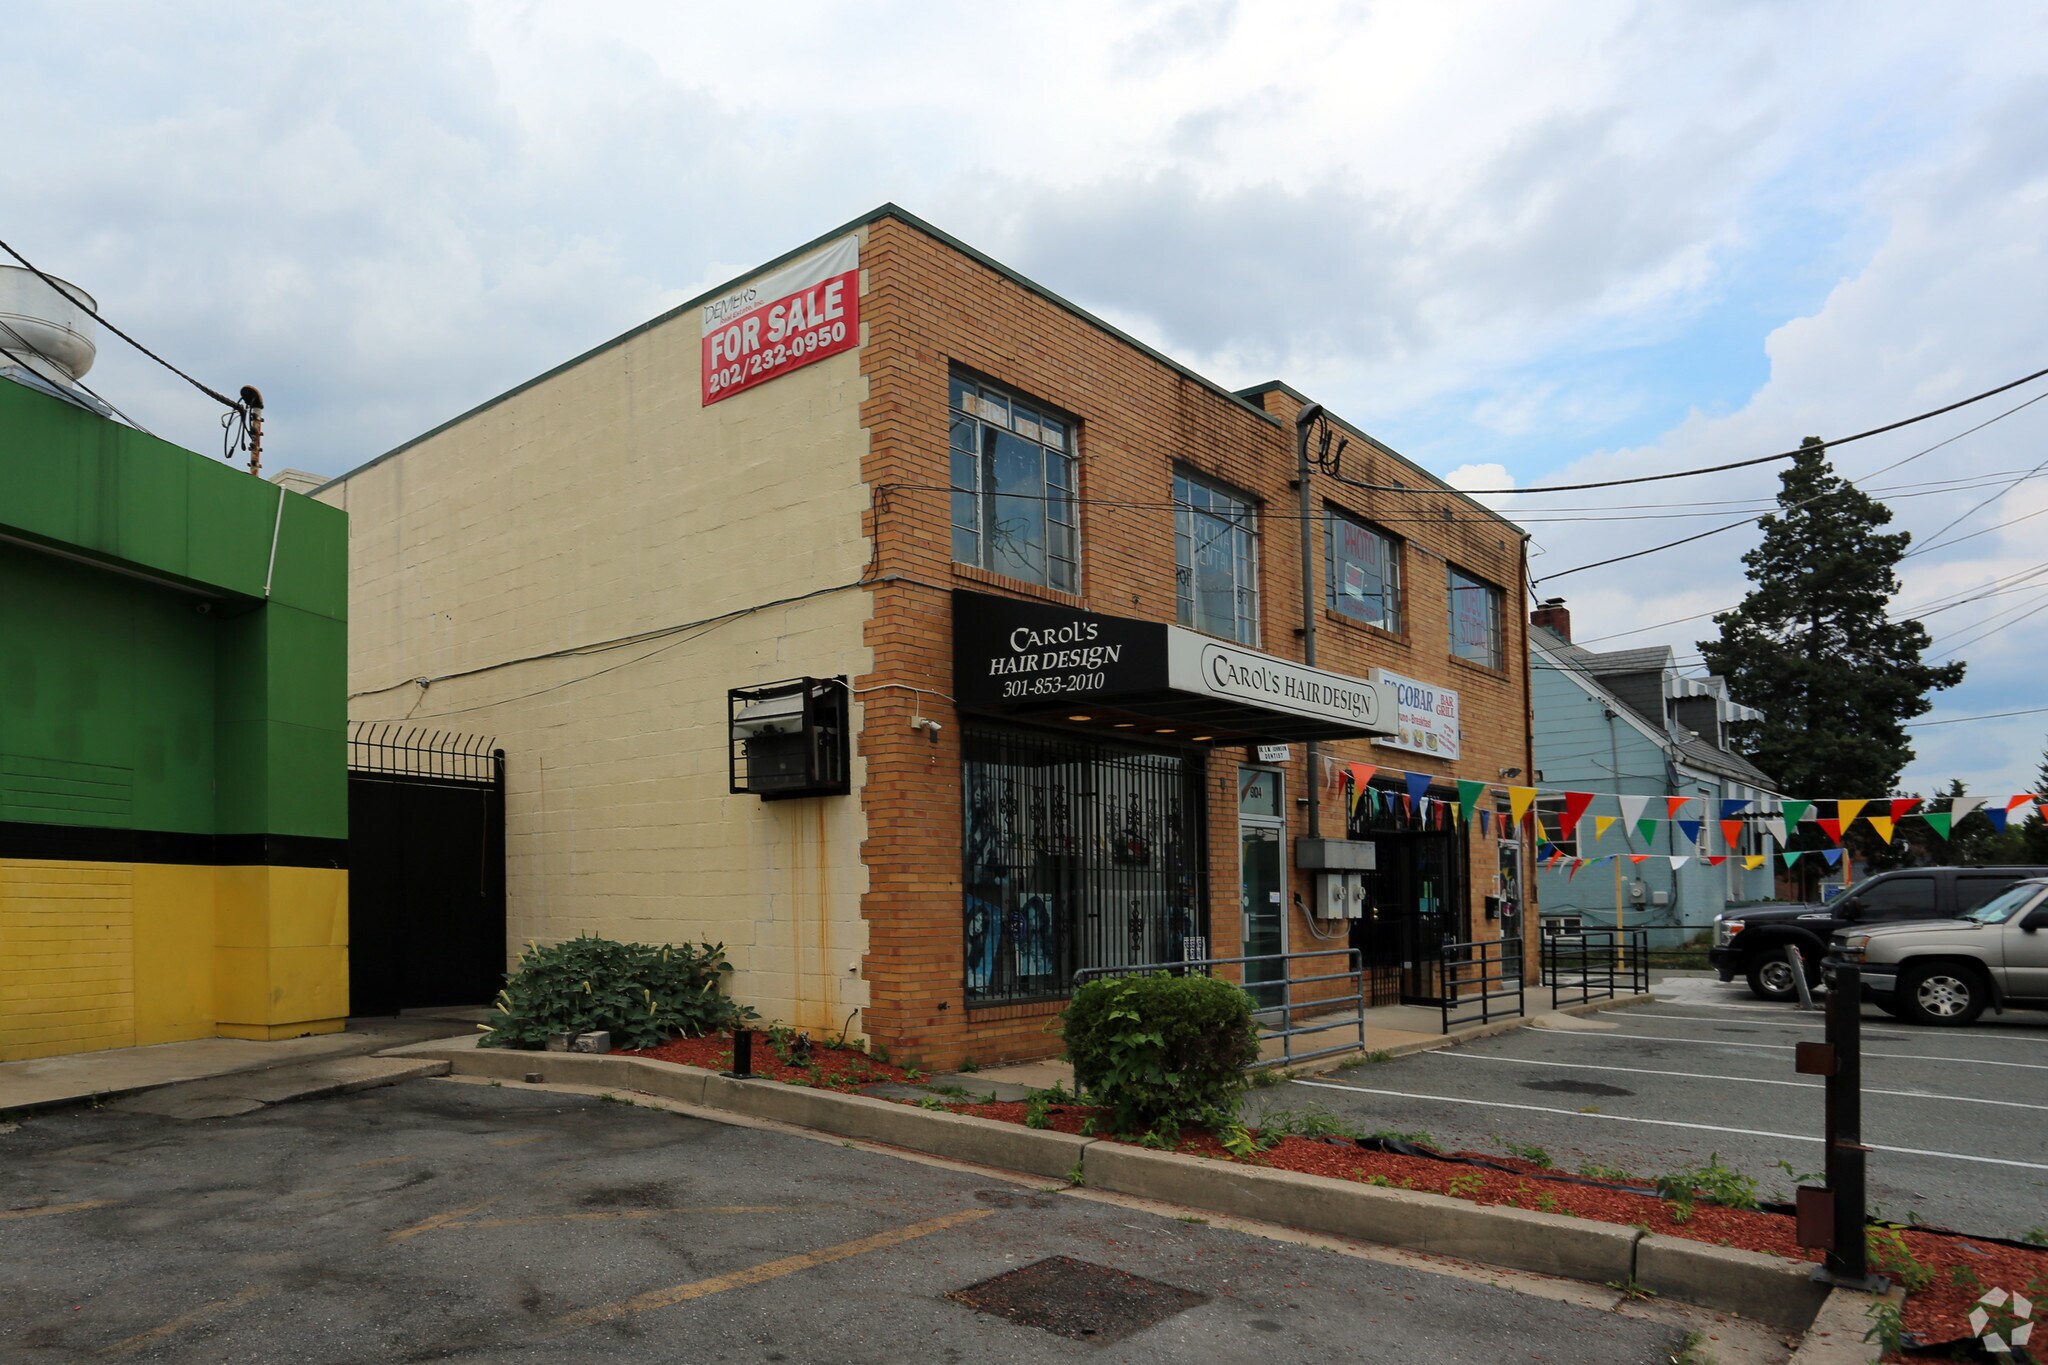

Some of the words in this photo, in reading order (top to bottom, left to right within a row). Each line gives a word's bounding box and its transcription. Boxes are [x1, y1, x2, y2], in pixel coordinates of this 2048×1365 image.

[703, 287, 757, 324] DEMERS
[711, 316, 760, 371] FOR
[767, 279, 844, 343] SALE
[709, 321, 847, 394] 202/232-0950
[1343, 522, 1376, 566] PHOTO
[989, 653, 1039, 676] HAIR
[1002, 672, 1105, 698] 301-853-2010
[1284, 675, 1321, 704] HAIR
[1384, 679, 1433, 712] COBAR
[1436, 704, 1455, 718] GRILL
[1440, 694, 1454, 708] BAR
